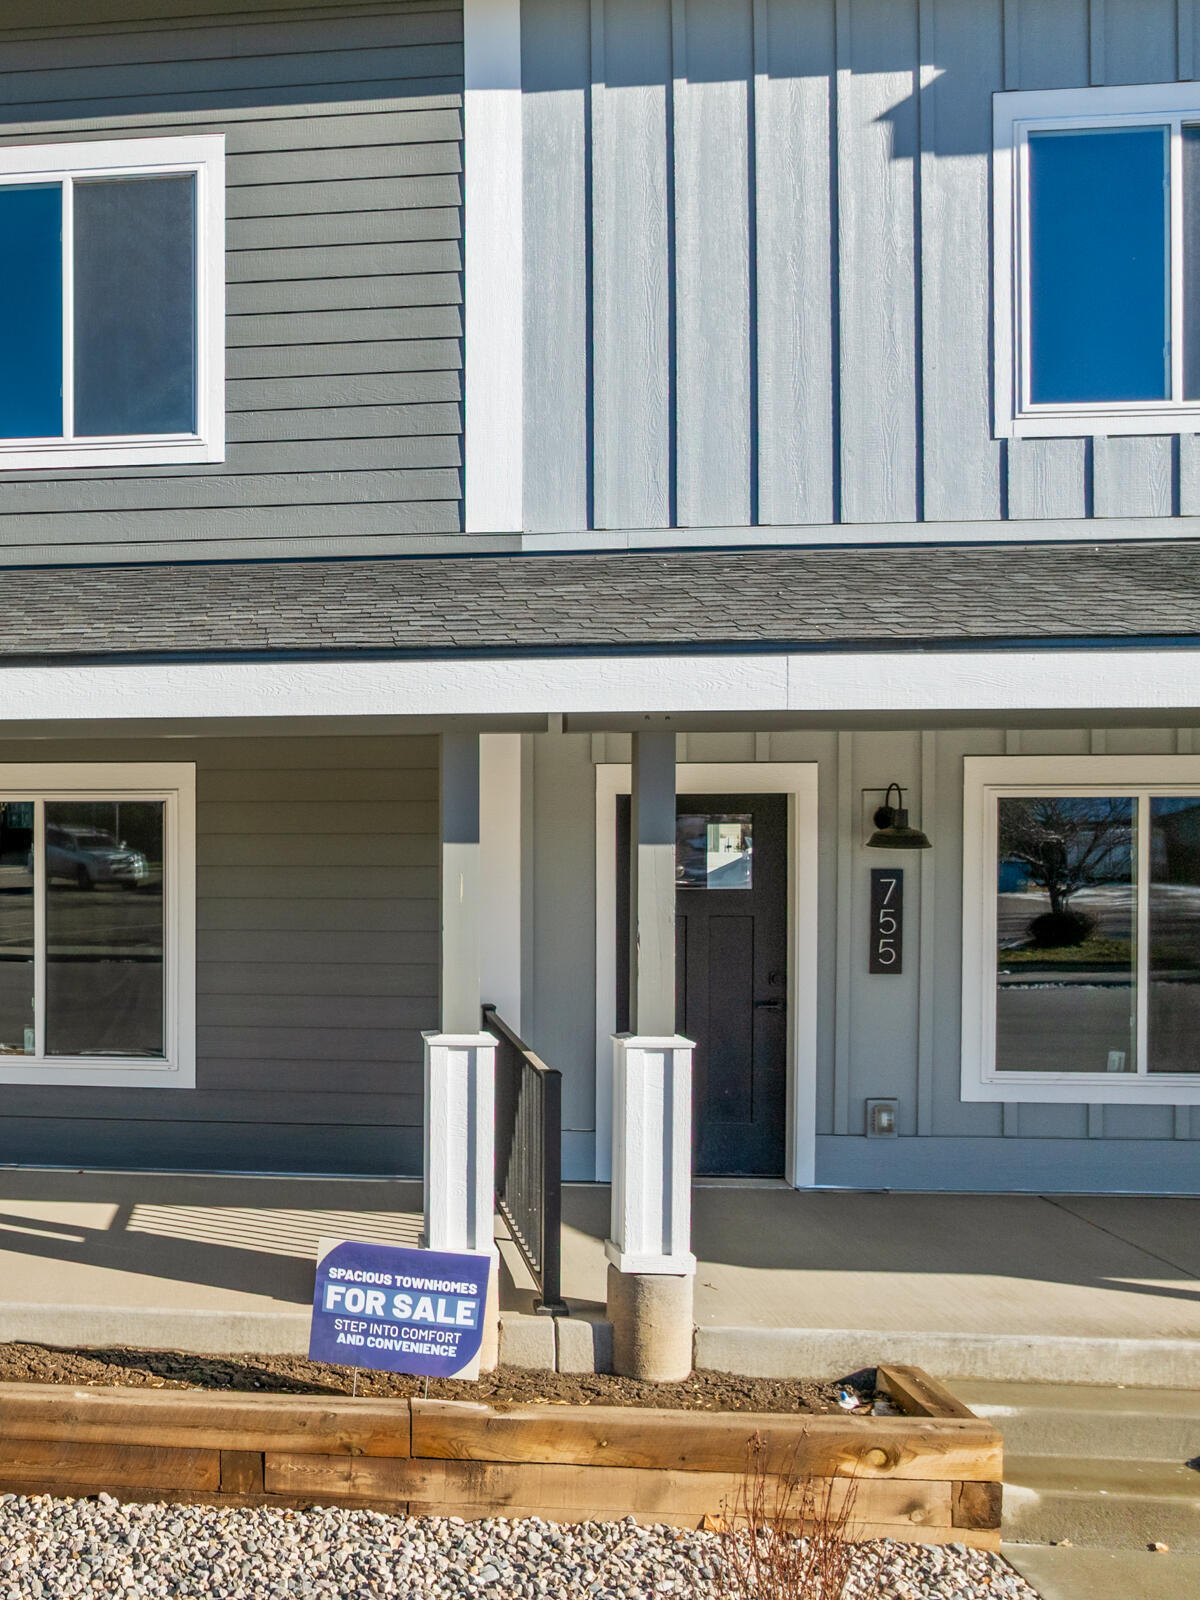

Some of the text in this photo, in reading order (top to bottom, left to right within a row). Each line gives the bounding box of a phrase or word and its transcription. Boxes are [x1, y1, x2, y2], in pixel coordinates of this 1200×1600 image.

[878, 878, 897, 965] 755
[328, 1266, 478, 1295] SPACIOUS TOWNHOMES
[326, 1284, 477, 1326] FOR SALE
[334, 1318, 462, 1344] STEP INTO COMFORT
[336, 1332, 458, 1358] AND CONVENIENCE
